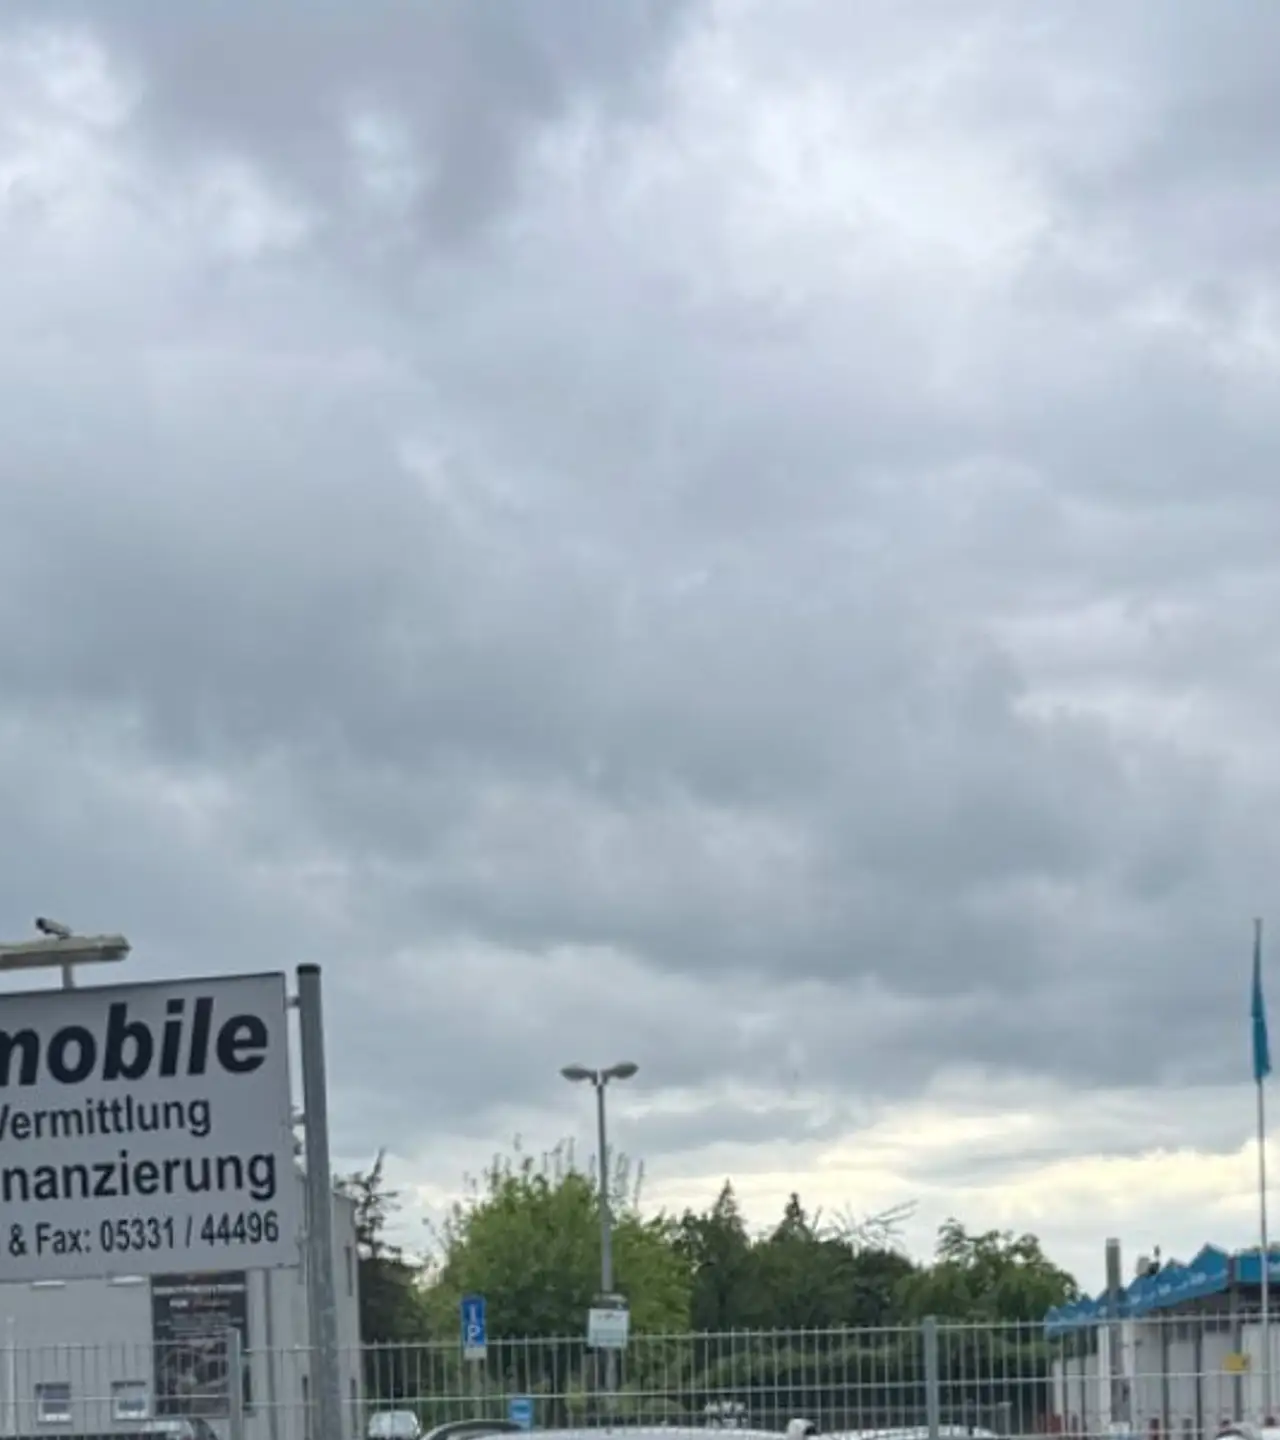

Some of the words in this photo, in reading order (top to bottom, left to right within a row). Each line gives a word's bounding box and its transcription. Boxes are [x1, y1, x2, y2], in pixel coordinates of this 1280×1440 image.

[8, 1222, 28, 1257] &
[35, 1220, 92, 1256] Fax:
[100, 1213, 173, 1252] 05331
[200, 1210, 279, 1246] 44496
